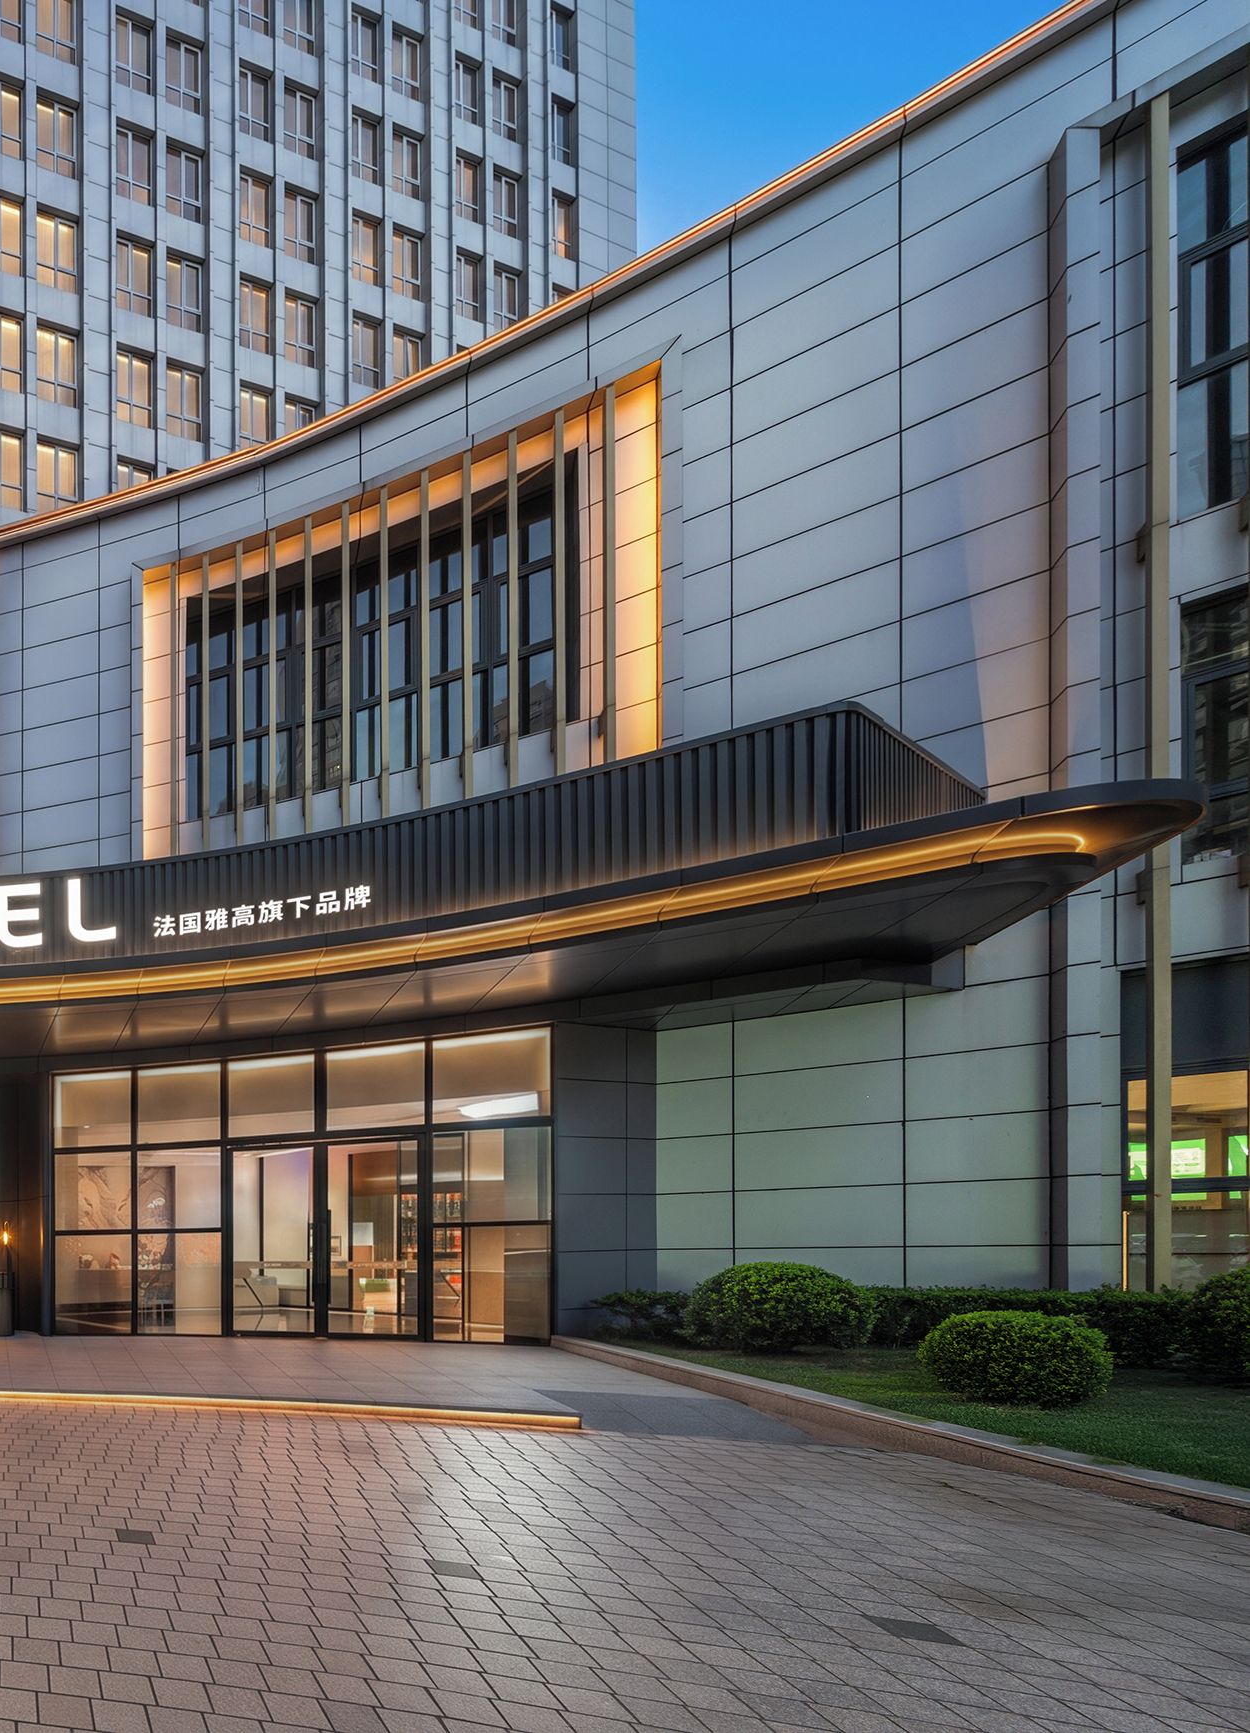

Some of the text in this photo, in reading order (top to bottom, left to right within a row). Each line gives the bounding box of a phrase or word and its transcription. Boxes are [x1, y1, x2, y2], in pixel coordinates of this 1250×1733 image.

[153, 885, 372, 937] 法国雅高旗下品牌
